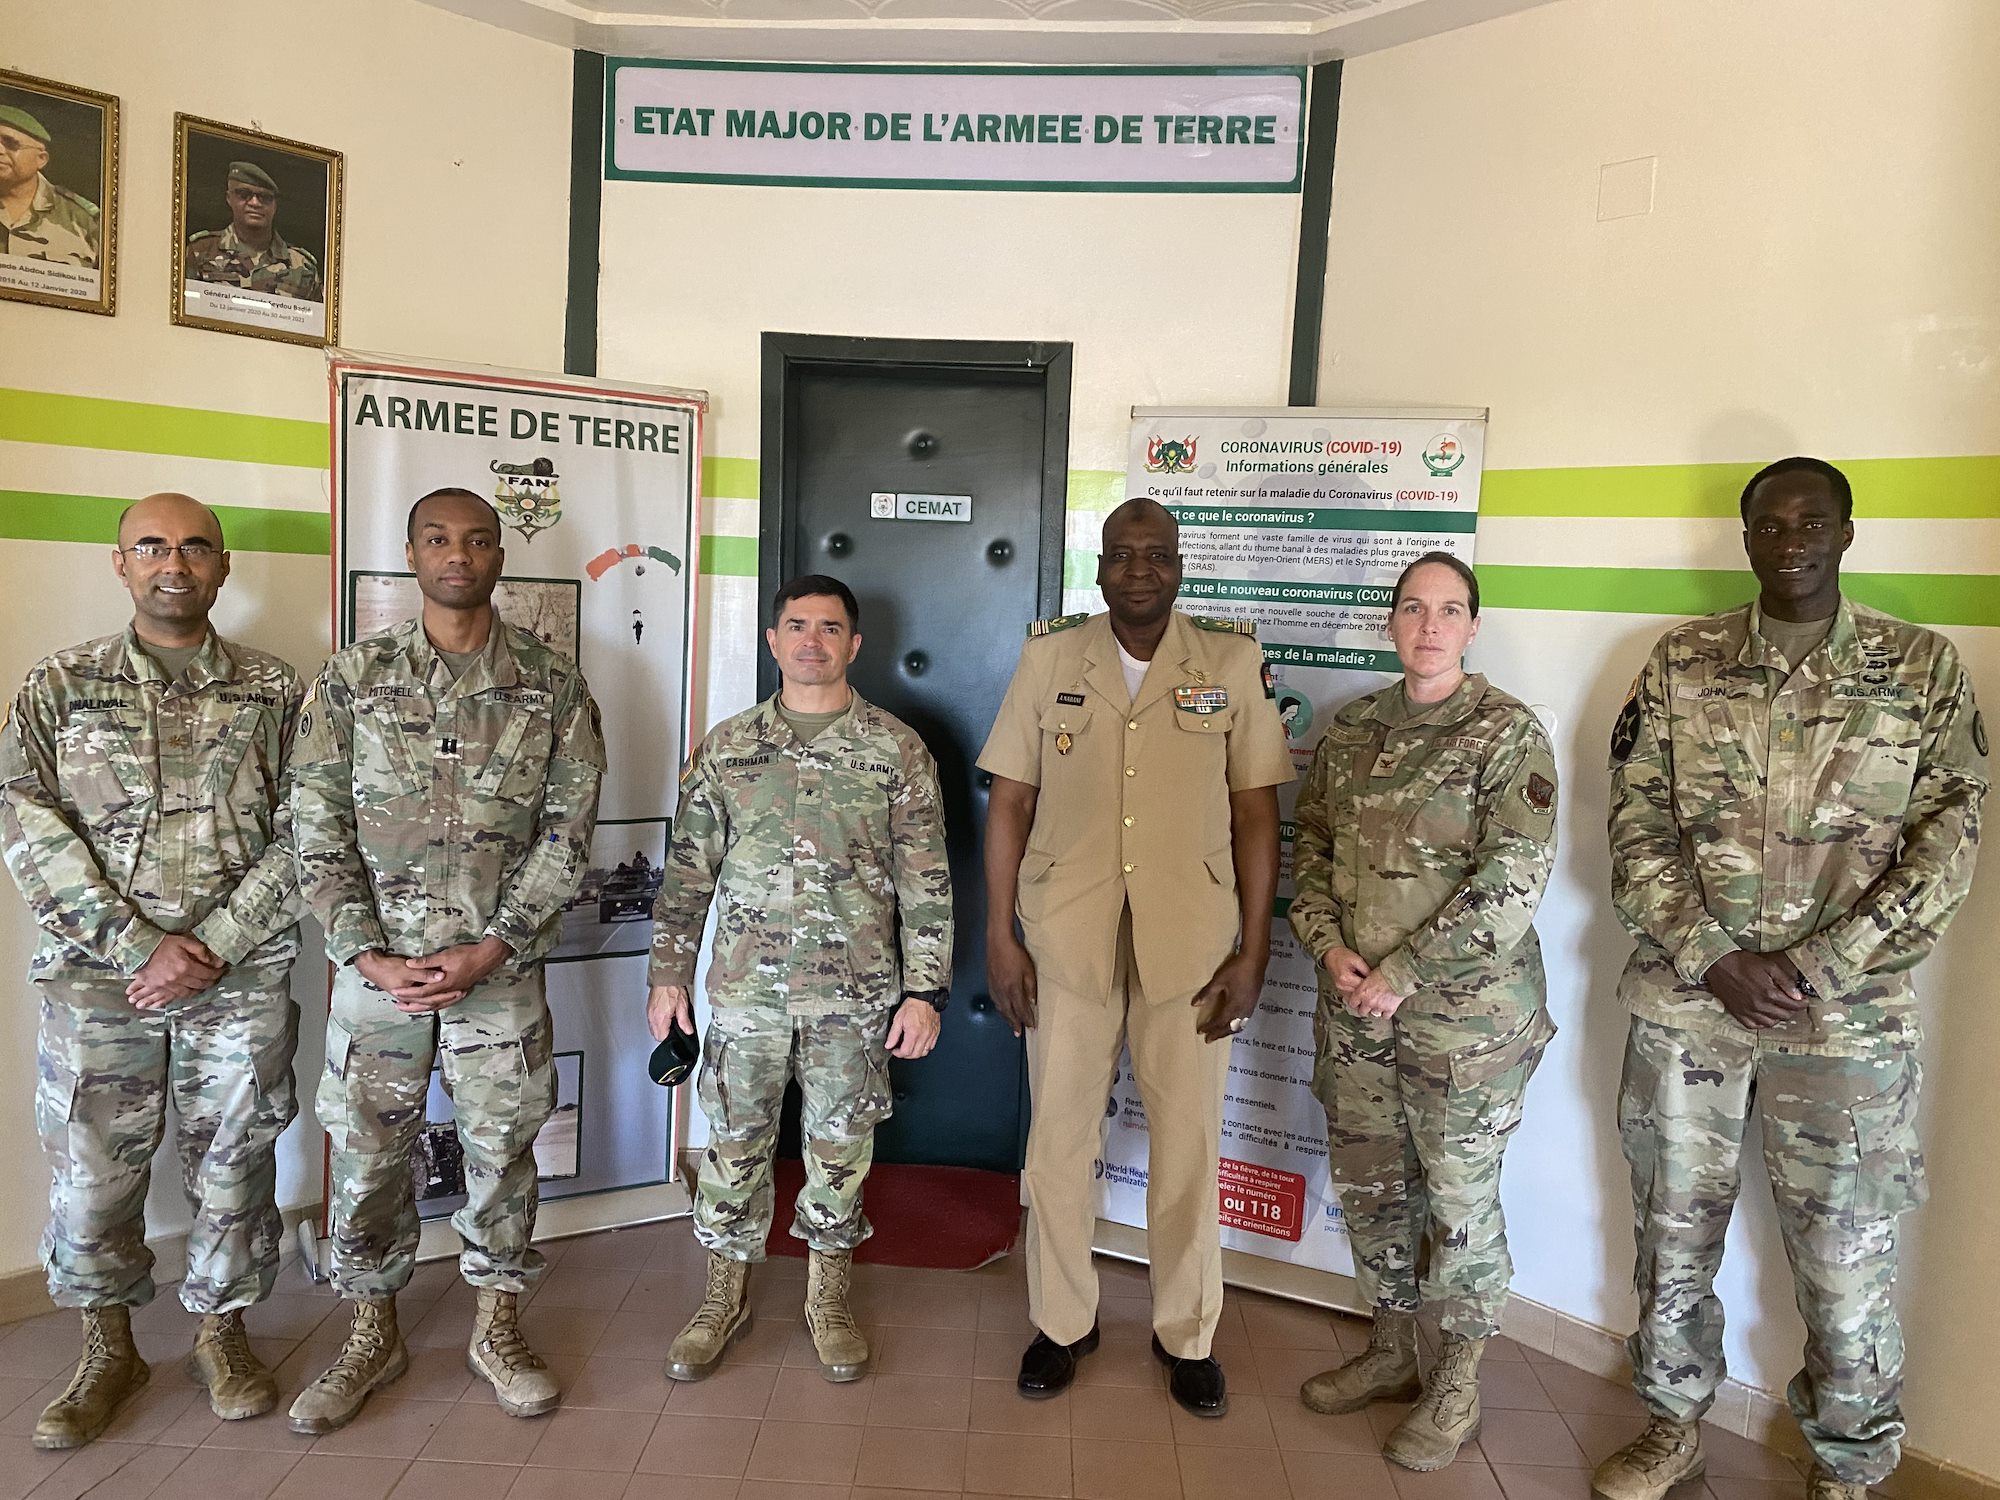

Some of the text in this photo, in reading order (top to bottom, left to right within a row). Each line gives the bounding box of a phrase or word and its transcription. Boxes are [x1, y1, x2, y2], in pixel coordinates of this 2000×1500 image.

[634, 106, 1277, 144] ETAT MAJOR DE L'ARMEE DE TERRE
[18, 279, 28, 287] Au
[19, 265, 45, 275] Abdou
[78, 275, 94, 284] Issa
[203, 289, 231, 299] Général
[269, 300, 292, 311] Seydou
[354, 394, 681, 455] ARMEE DE TERRE
[1220, 440, 1402, 457] CORONAVIRUS (COVID-19)
[1226, 460, 1389, 476] Informations générales
[507, 476, 551, 488] FAN
[1148, 486, 1161, 496] Ce
[1184, 487, 1203, 497] faut
[1206, 488, 1238, 498] retenir
[1240, 490, 1256, 498] sur
[1258, 488, 1267, 498] la
[1270, 488, 1311, 499] maladie
[1313, 489, 1326, 499] du
[1328, 489, 1393, 500] Coronavirus
[1396, 490, 1459, 503] (COVID-19)
[905, 500, 962, 516] CEMAT
[1182, 511, 1195, 521] ce
[1198, 511, 1220, 524] que
[1222, 509, 1233, 522] le
[1235, 511, 1305, 524] coronavirus
[1307, 512, 1316, 524] ?
[1178, 531, 1206, 540] navirus
[1209, 531, 1240, 541] forment
[1261, 534, 1284, 542] vaste
[1287, 533, 1315, 543] famille
[1318, 535, 1329, 544] de
[1332, 536, 1352, 544] virus
[1356, 536, 1370, 547] qui
[1373, 537, 1393, 546] sont
[1396, 537, 1403, 546] à
[1444, 538, 1456, 547] de
[1219, 543, 1240, 552] allant
[1242, 543, 1253, 552] du
[1254, 544, 1280, 553] rhume
[1282, 544, 1305, 553] banal
[1306, 544, 1313, 553] à
[1314, 545, 1329, 555] des
[1330, 546, 1369, 556] maladies
[1370, 548, 1390, 558] plus
[1391, 549, 1420, 559] graves
[1187, 562, 1217, 573] (SRAS).
[1190, 552, 1235, 562] respiratoire
[1235, 554, 1246, 562] du
[1247, 554, 1301, 565] Moyen-Orient
[1302, 556, 1334, 566] (MERS)
[1335, 558, 1345, 566] et
[1345, 557, 1353, 566] le
[1355, 558, 1399, 569] Syndrome
[1193, 583, 1215, 595] que
[1217, 582, 1228, 594] le
[1230, 585, 1280, 597] nouveau
[1282, 587, 1354, 600] coronavirus
[1356, 588, 1393, 603] (COVI
[1186, 603, 1231, 613] coronavirus
[1234, 605, 1247, 613] est
[1250, 607, 1265, 615] une
[1268, 607, 1302, 617] nouvelle
[1306, 609, 1336, 619] souche
[1339, 610, 1350, 619] de
[1353, 612, 1388, 621] coronav
[1310, 620, 1320, 629] en
[1322, 620, 1363, 631] décembre
[1365, 622, 1387, 632] 2019
[1284, 648, 1300, 660] de
[1302, 648, 1314, 661] la
[1316, 650, 1366, 665] maladie
[1368, 653, 1376, 666] ?
[369, 685, 413, 698] MITCHELL
[1697, 686, 1726, 698] JOHN
[726, 754, 770, 769] CASHMAN
[869, 763, 896, 776] ARMY
[1280, 981, 1301, 991] votre
[1302, 984, 1318, 994] cou
[1259, 1002, 1315, 1019] distance entr
[1252, 1038, 1316, 1058] le nez et la bouc
[1239, 1067, 1259, 1078] vous
[1260, 1072, 1288, 1083] donner
[1289, 1075, 1297, 1085] la
[1235, 1096, 1278, 1112] essentiels.
[1227, 1119, 1262, 1135] contacts
[1263, 1127, 1282, 1138] avec
[1283, 1130, 1297, 1141] les
[1297, 1134, 1325, 1147] autres
[1238, 1131, 1278, 1148] difficultés
[1283, 1141, 1290, 1151] à
[1295, 1144, 1329, 1158] respirer
[1105, 1162, 1148, 1180] World Healt
[1222, 1160, 1232, 1170] de
[1231, 1162, 1239, 1171] la
[1261, 1170, 1271, 1179] de
[1271, 1171, 1279, 1181] la
[1105, 1170, 1147, 1189] Organizatio
[1236, 1182, 1278, 1202] le numéro
[1223, 1196, 1245, 1213] ou
[1250, 1199, 1282, 1222] 118
[1232, 1216, 1242, 1227] et
[1242, 1218, 1291, 1238] orientations
